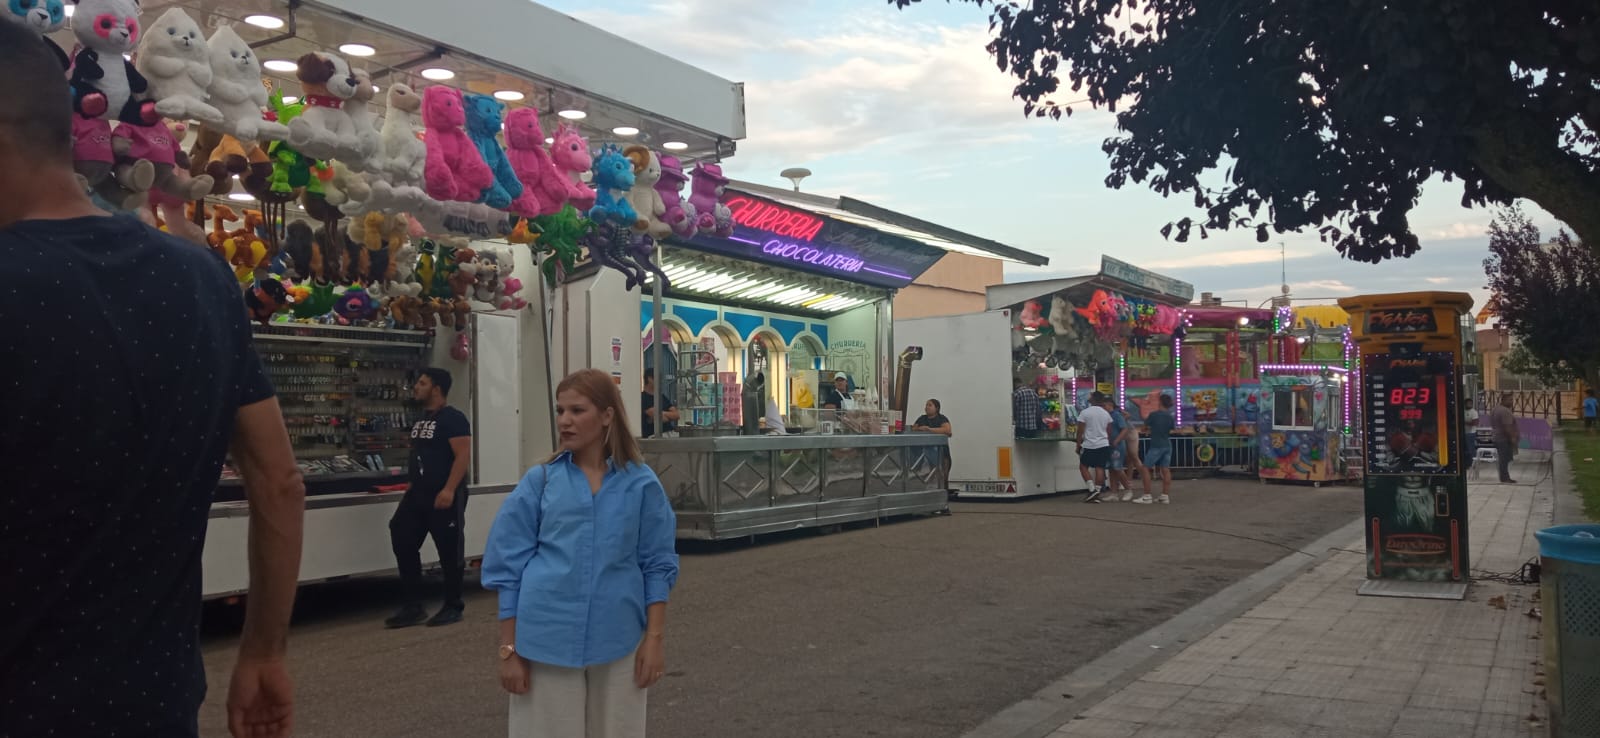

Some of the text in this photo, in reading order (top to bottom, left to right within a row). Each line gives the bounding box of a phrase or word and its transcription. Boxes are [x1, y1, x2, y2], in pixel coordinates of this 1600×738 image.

[725, 197, 824, 242] CHURRERIA
[763, 239, 864, 273] CHOCOLATERIA
[1390, 387, 1430, 405] 823
